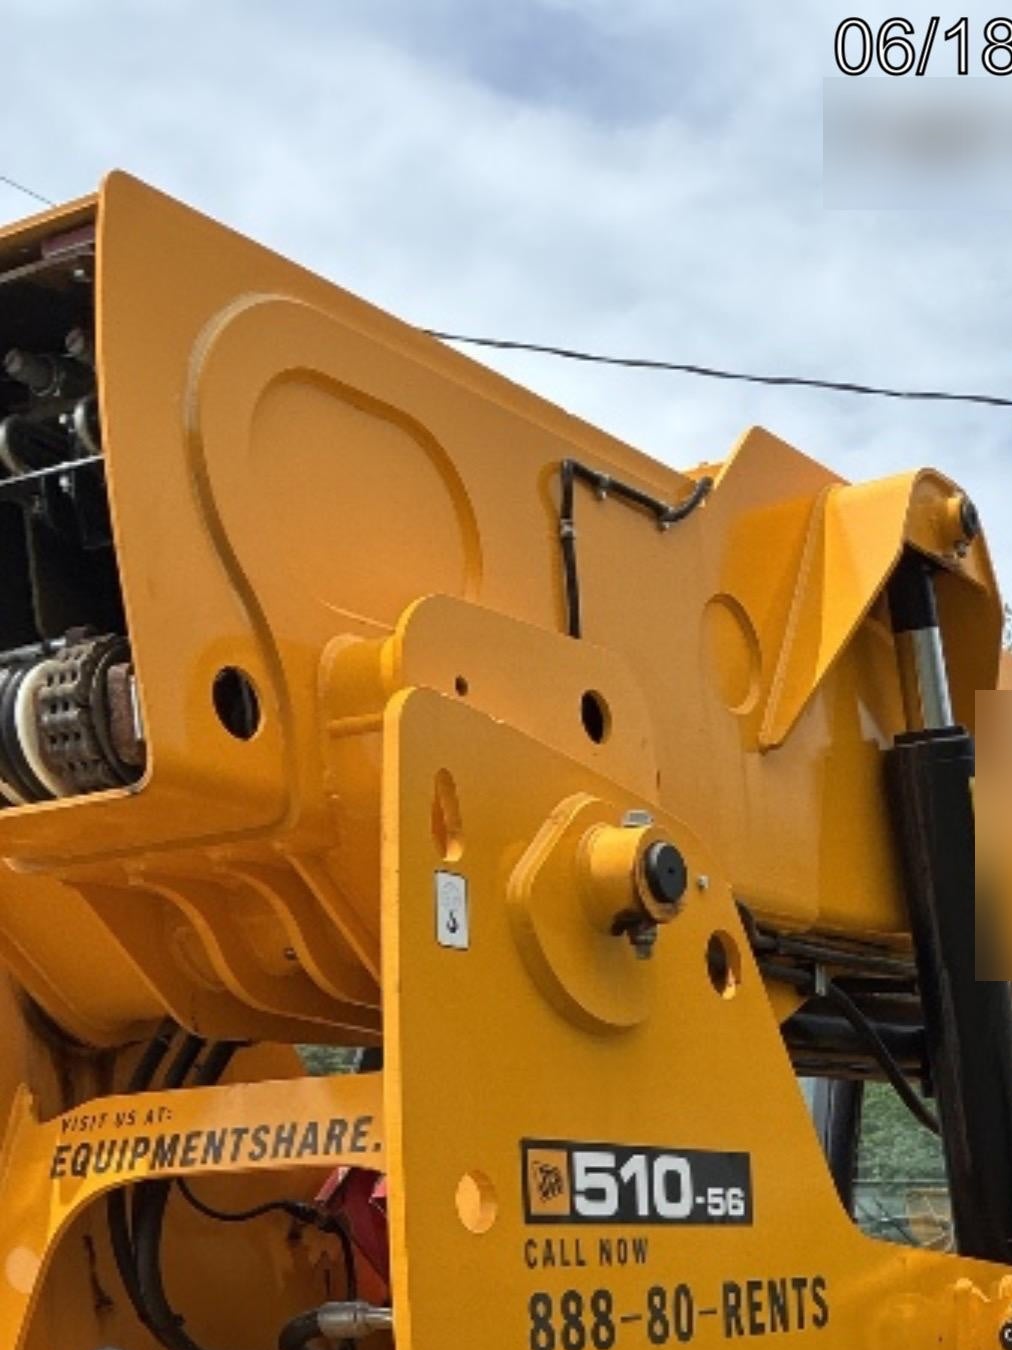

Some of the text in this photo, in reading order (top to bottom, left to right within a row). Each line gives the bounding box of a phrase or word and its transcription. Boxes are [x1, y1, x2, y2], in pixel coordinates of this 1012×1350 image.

[60, 1106, 174, 1134] VISIT US AT:
[523, 1237, 649, 1269] CALL NOW
